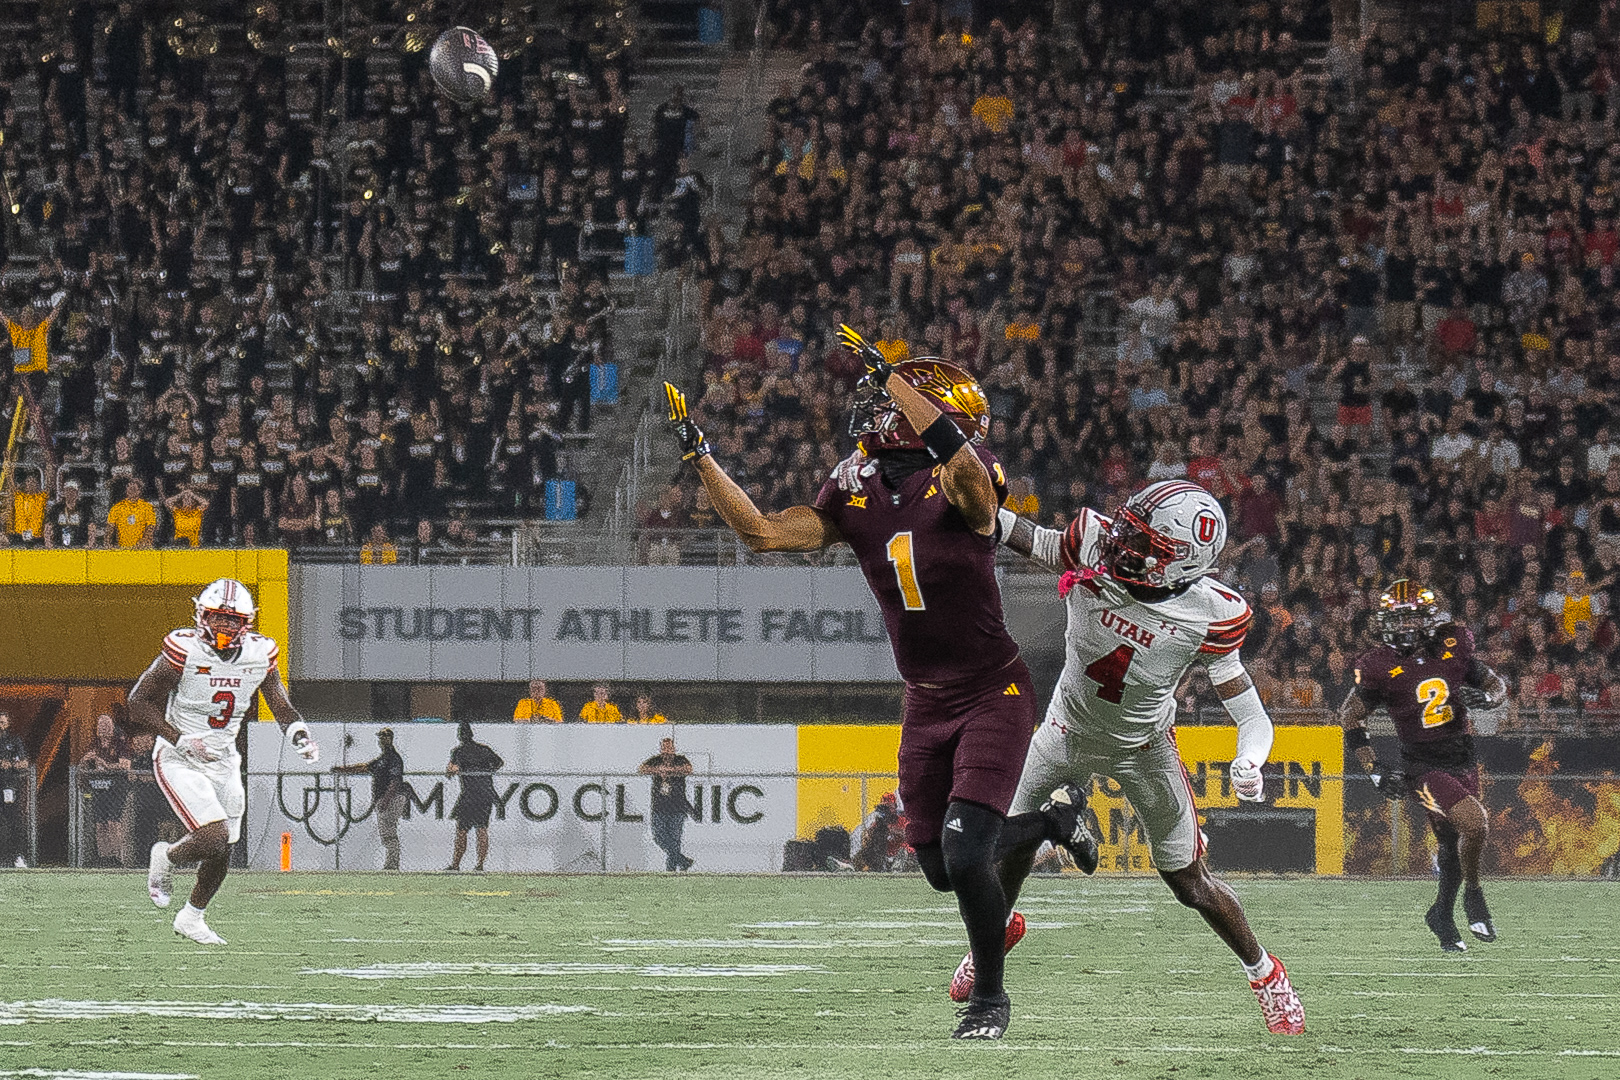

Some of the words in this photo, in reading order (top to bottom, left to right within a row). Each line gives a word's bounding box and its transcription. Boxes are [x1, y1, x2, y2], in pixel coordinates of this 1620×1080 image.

[1199, 515, 1216, 543] U
[886, 531, 926, 611] 1
[338, 607, 541, 641] STUDENT
[555, 608, 743, 643] ATHLETE
[1100, 608, 1155, 649] UTAH
[209, 677, 241, 688] UTAH
[1085, 643, 1134, 705] 4
[207, 690, 236, 730] 3
[1416, 677, 1454, 729] 2
[401, 781, 558, 823] MYO
[572, 782, 764, 825] CLNIC
